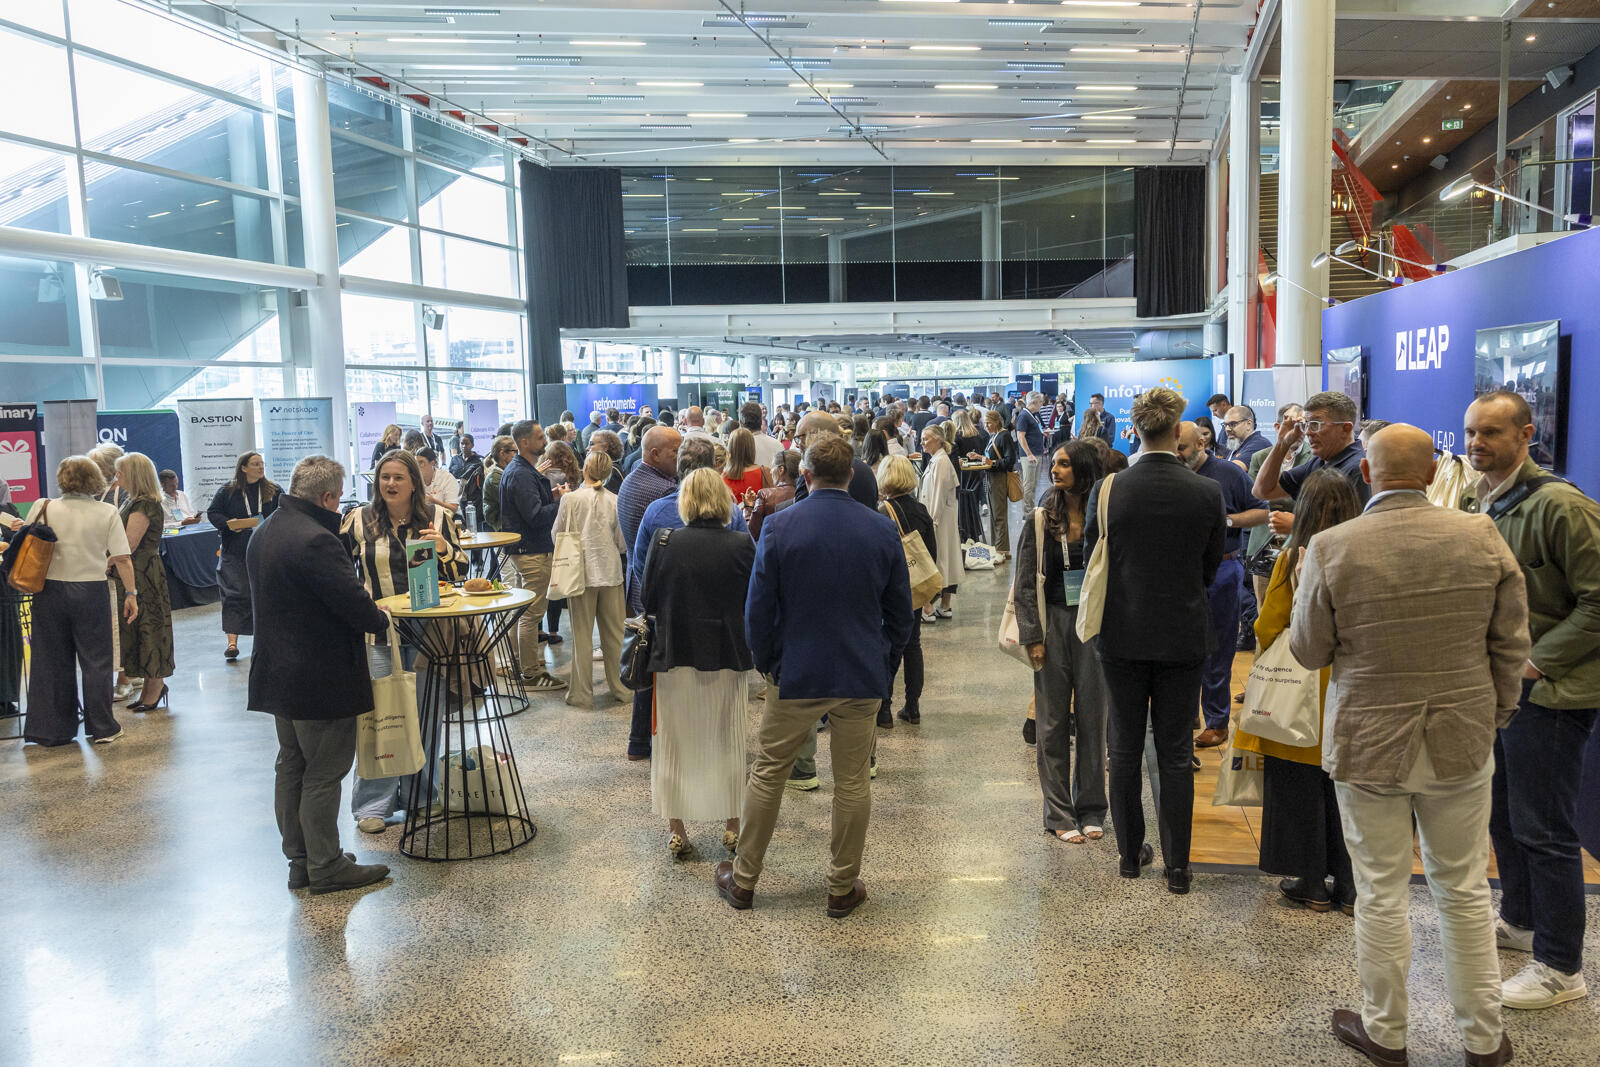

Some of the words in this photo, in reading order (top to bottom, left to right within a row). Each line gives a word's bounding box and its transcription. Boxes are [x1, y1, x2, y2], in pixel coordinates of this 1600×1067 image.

[1409, 325, 1449, 370] LEAP
[1103, 383, 1175, 398] InfoTrk
[593, 396, 636, 411] netdocuments
[0, 406, 36, 420] inary
[283, 406, 319, 414] netskope
[191, 415, 243, 424] BASTION
[1274, 677, 1302, 685] surprises
[1251, 708, 1272, 717] onelaw
